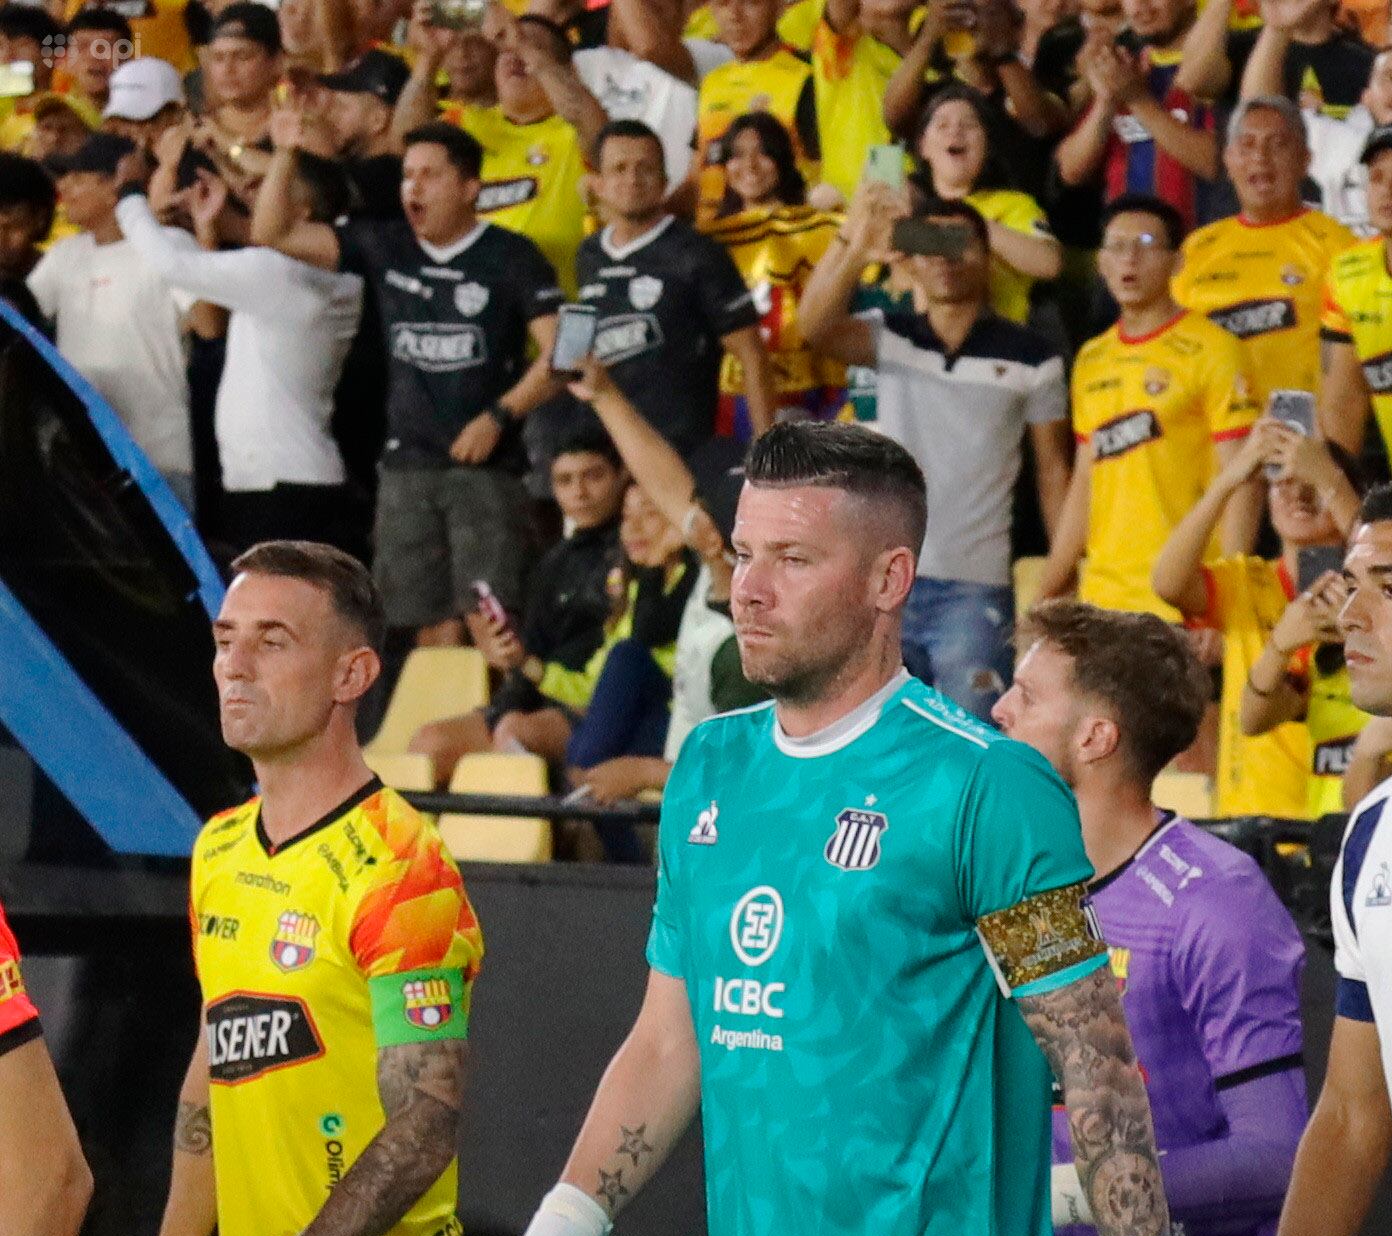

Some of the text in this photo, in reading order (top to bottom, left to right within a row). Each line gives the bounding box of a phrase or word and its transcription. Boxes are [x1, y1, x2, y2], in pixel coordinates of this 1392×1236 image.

[235, 870, 292, 897] marathon
[714, 976, 785, 1018] ICBC
[711, 1024, 784, 1051] Argentina
